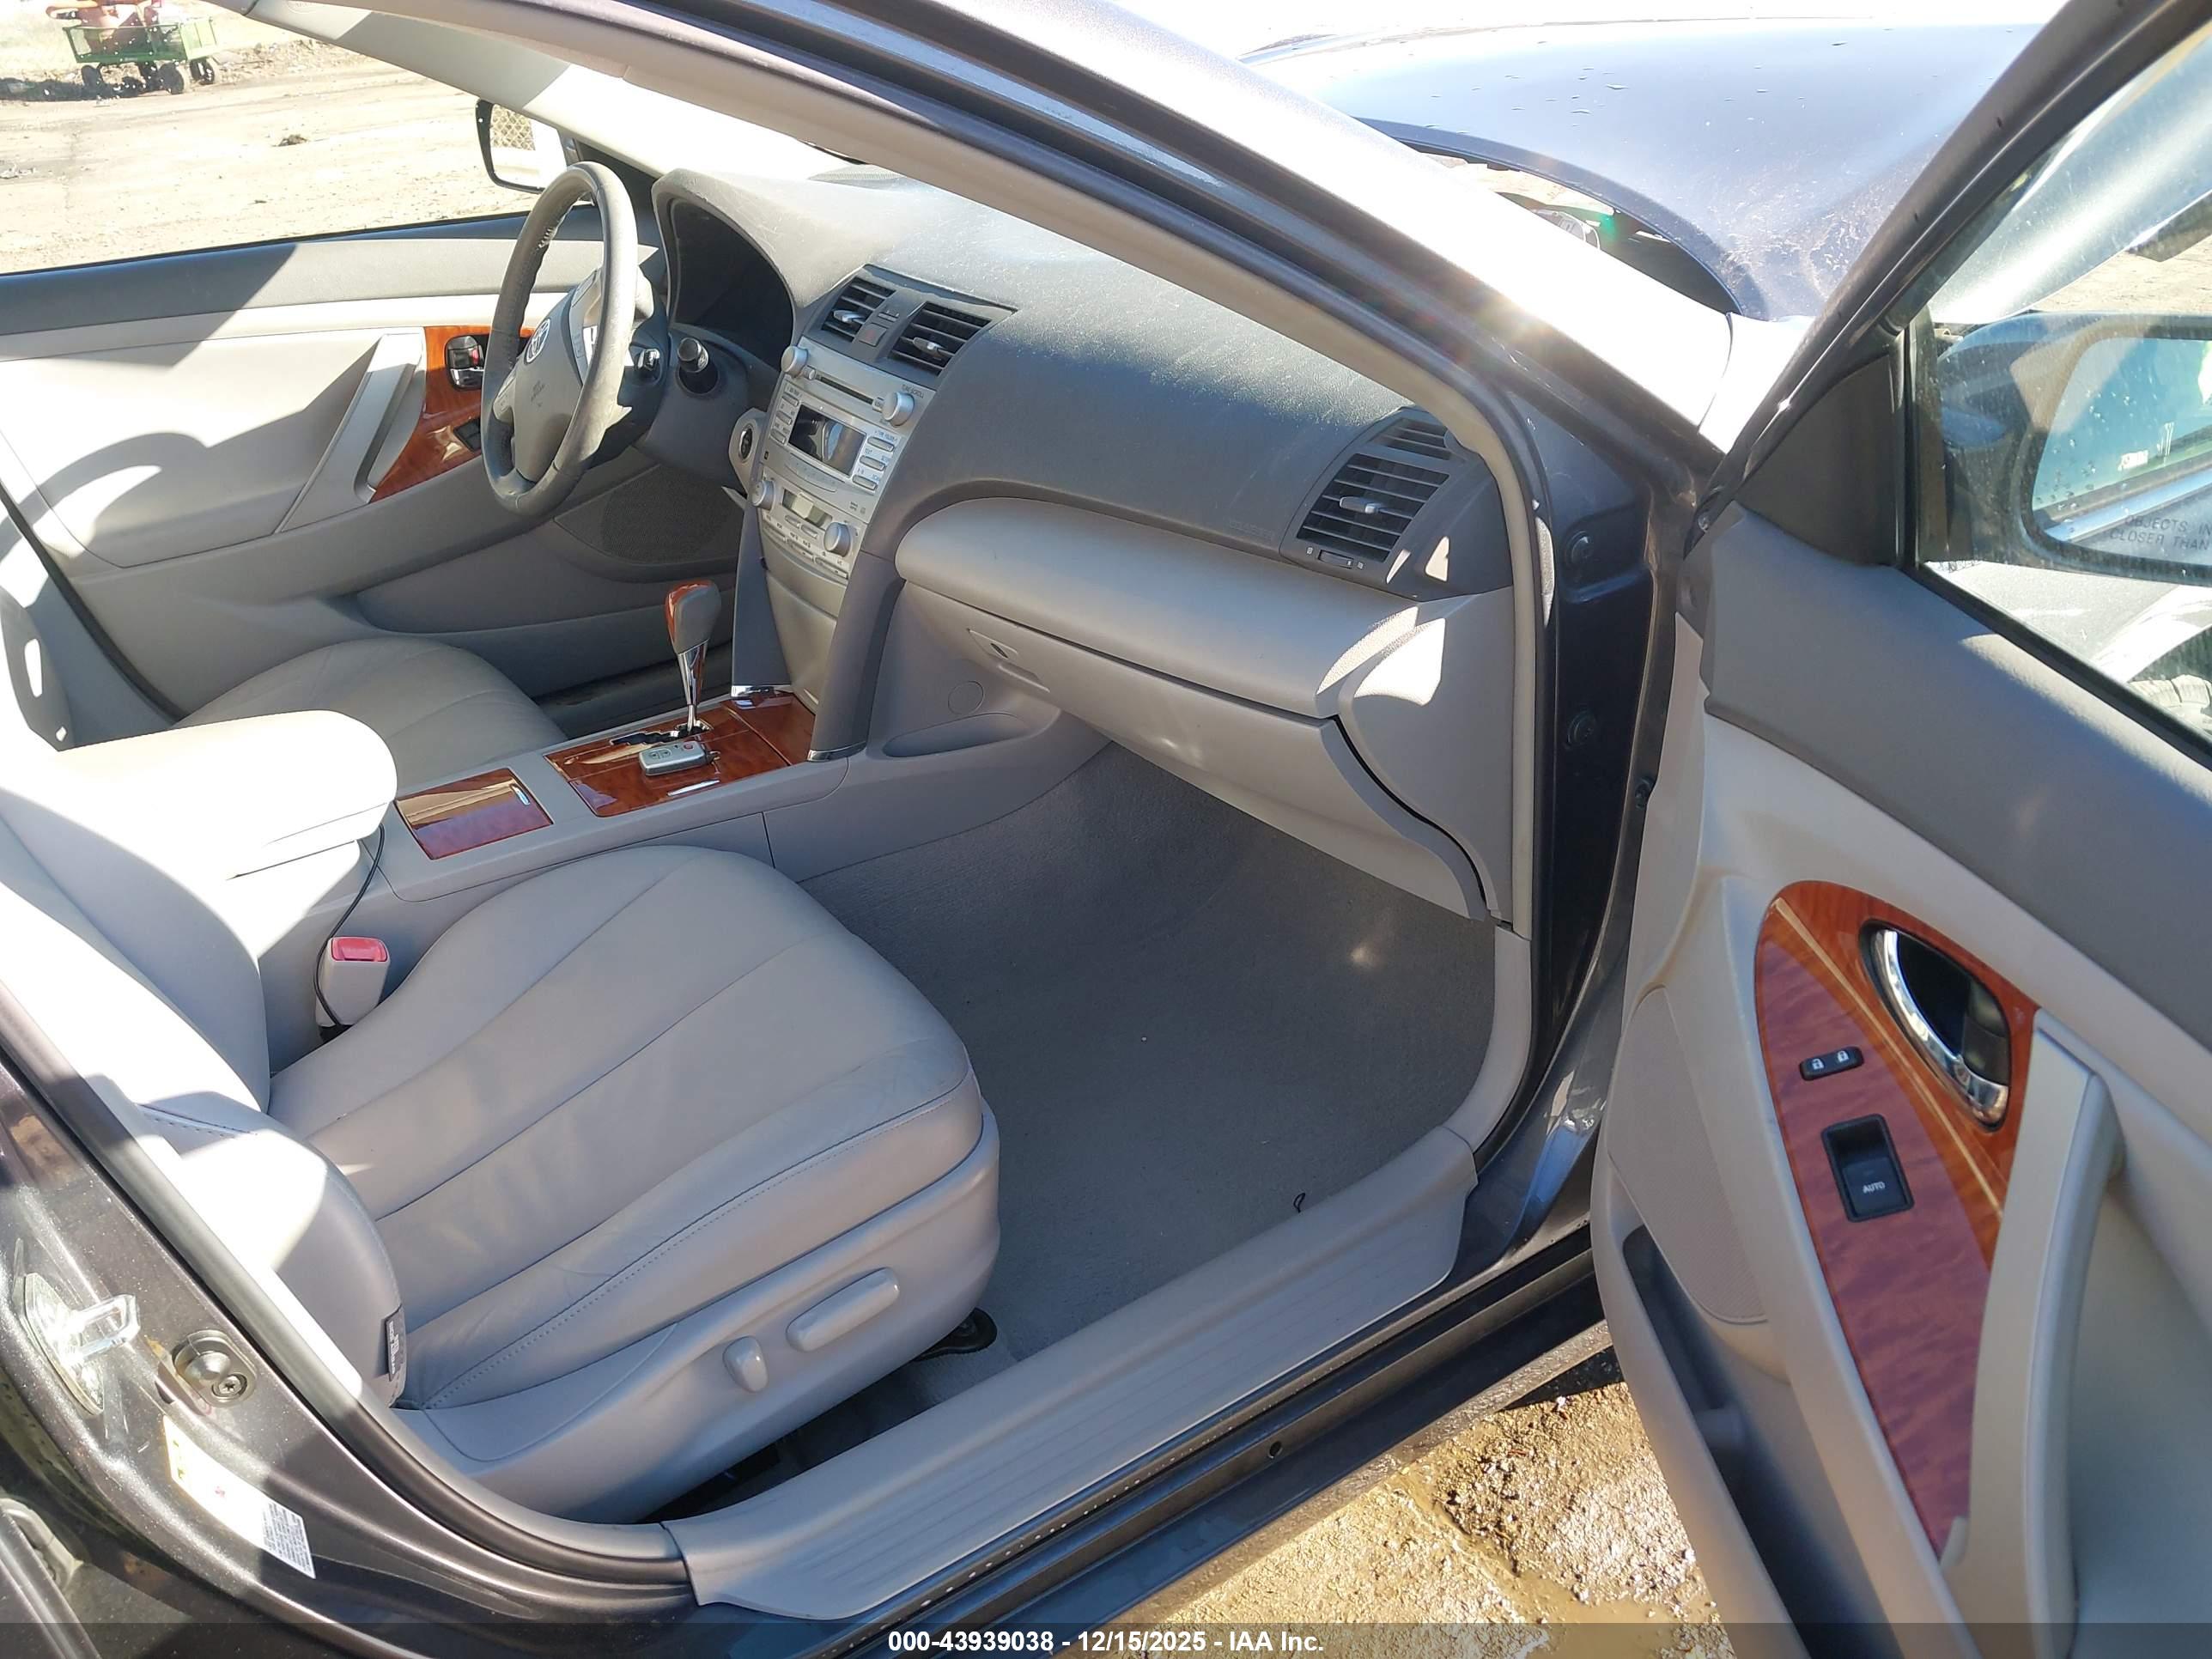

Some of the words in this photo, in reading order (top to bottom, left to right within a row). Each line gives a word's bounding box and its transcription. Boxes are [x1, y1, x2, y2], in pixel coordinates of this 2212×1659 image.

[2124, 516, 2188, 533] OBJECTS
[2109, 528, 2164, 545] CLOSER
[2172, 536, 2210, 550] THAN
[1863, 1182, 1886, 1194] AUTO
